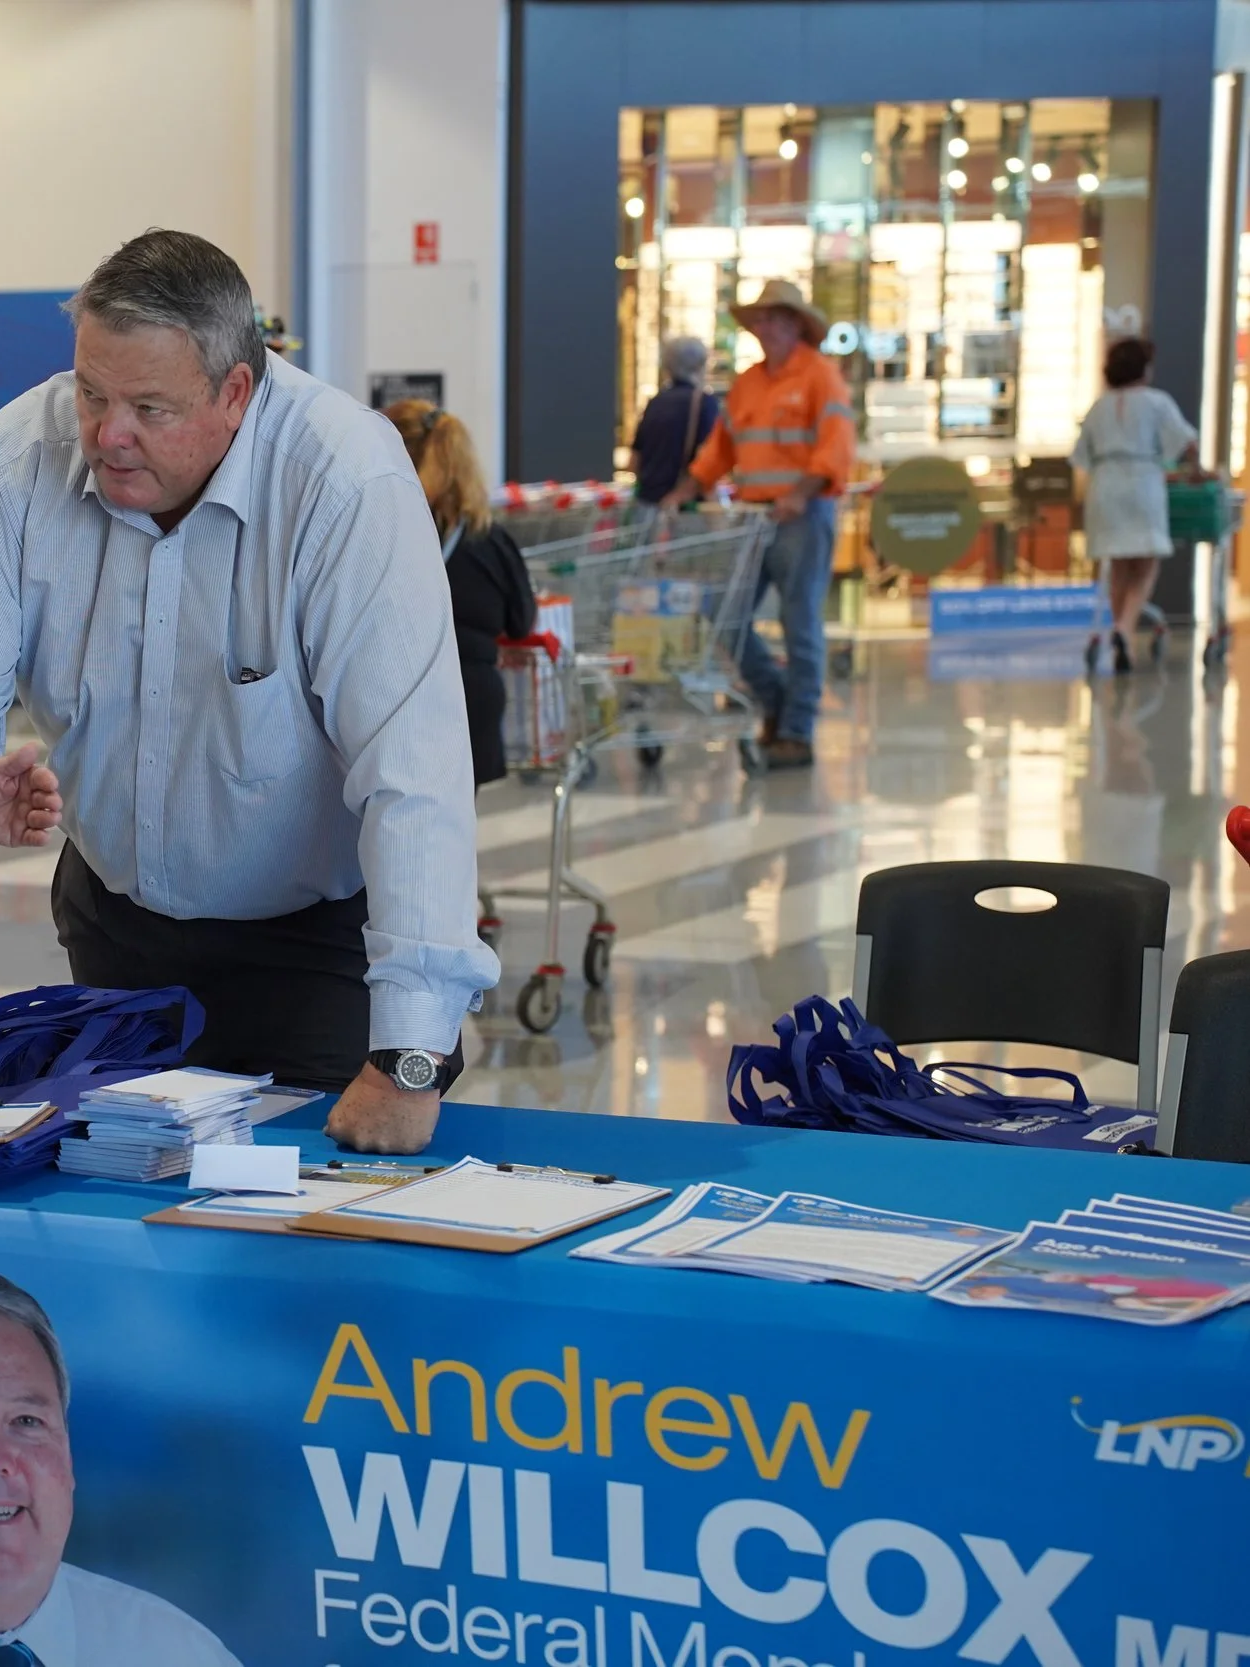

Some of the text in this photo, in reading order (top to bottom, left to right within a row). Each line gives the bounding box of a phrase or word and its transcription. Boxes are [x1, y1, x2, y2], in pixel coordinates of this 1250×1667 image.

[1090, 1244, 1187, 1264] Pension
[302, 1323, 872, 1490] Andrew
[1094, 1418, 1234, 1473] LNP
[301, 1444, 1094, 1667] WILLCOX
[1115, 1614, 1250, 1667] M
[314, 1568, 607, 1667] Federal
